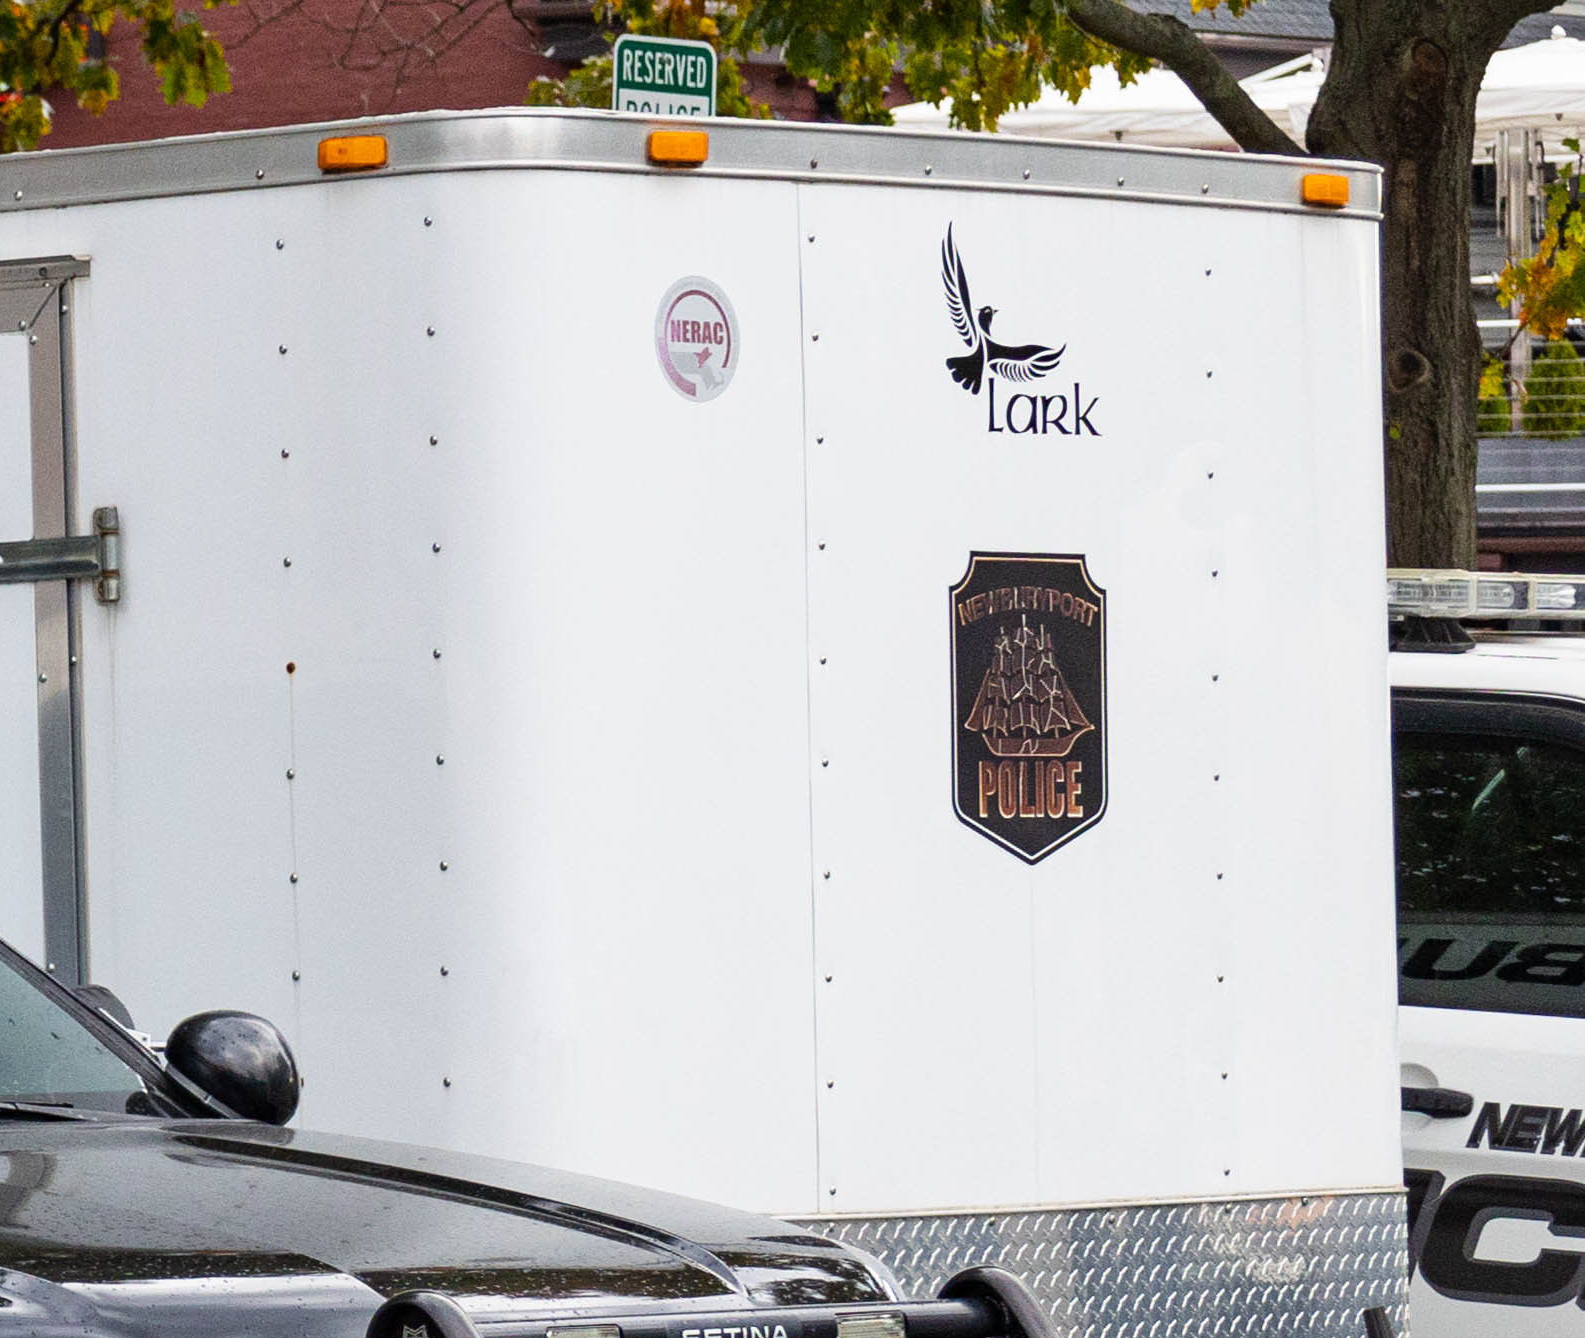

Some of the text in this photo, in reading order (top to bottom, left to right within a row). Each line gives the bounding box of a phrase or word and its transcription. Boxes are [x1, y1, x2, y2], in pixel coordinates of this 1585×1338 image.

[623, 48, 707, 88] RESERVED
[670, 320, 724, 345] NERAC
[958, 586, 1098, 626] NEWBURYPORT
[979, 760, 1083, 819] POLICE
